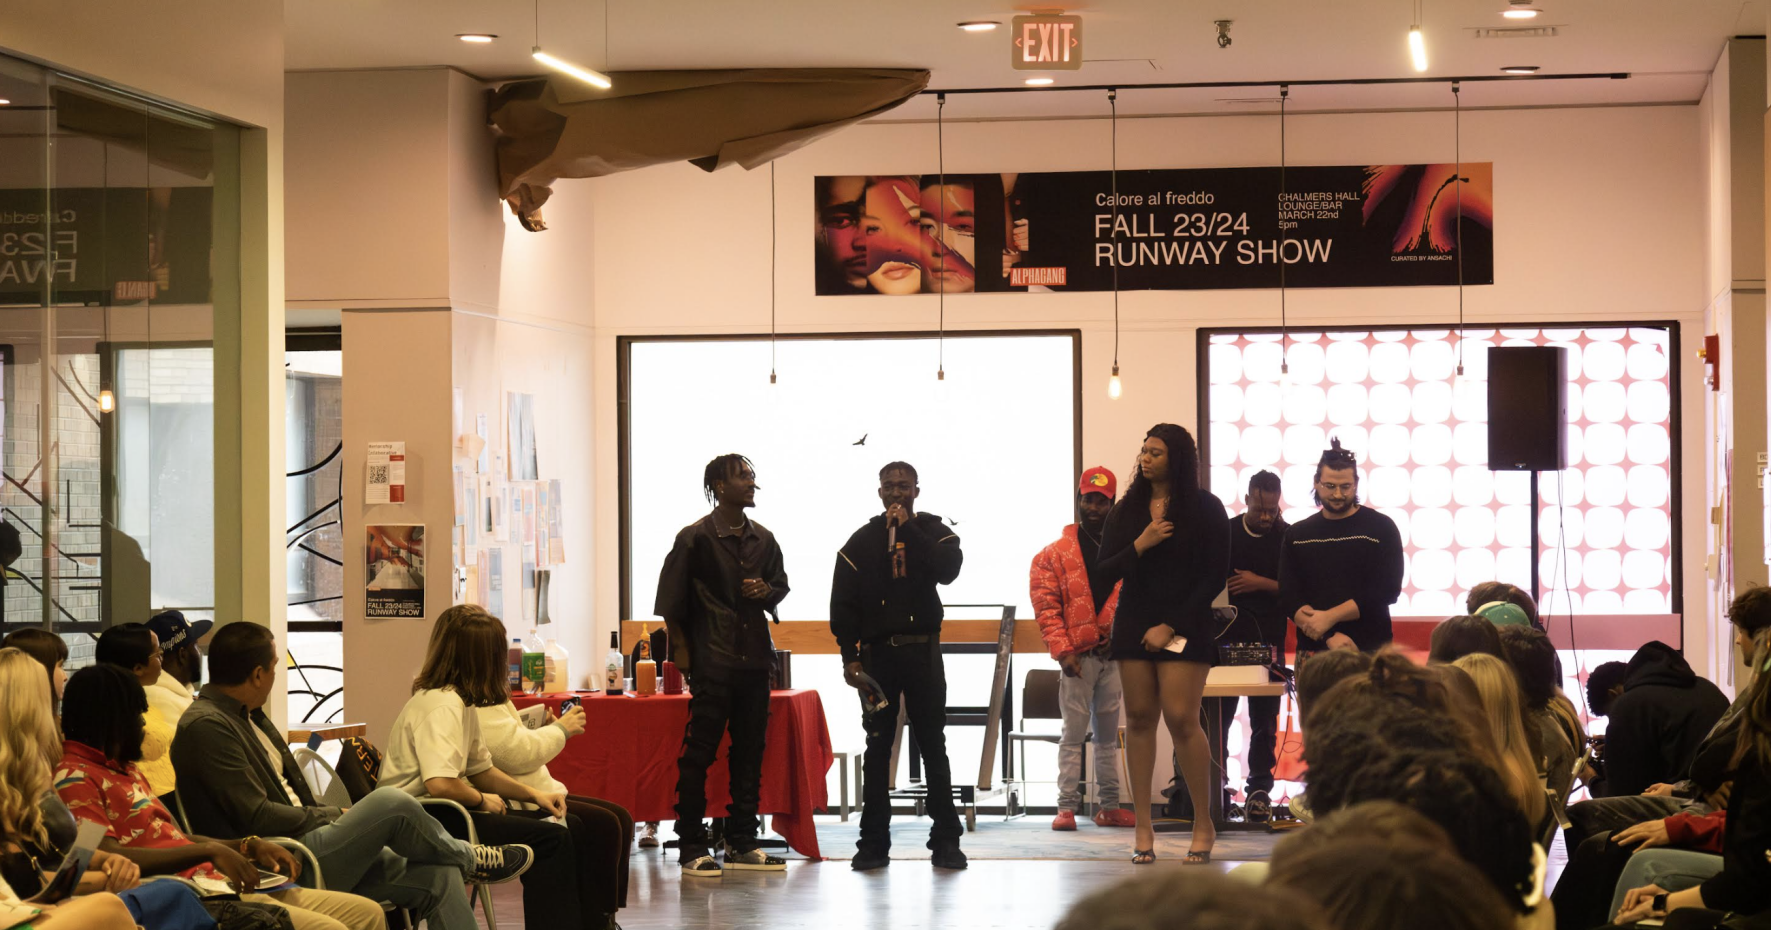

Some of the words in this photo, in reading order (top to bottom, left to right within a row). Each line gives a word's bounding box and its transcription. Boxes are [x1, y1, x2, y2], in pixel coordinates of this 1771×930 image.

[1023, 23, 1074, 62] EXIT
[1095, 192, 1143, 206] Calore
[1148, 192, 1161, 205] al
[1165, 191, 1215, 205] freddo
[1278, 192, 1333, 201] CHALMERS
[1335, 191, 1360, 200] HALL
[1278, 201, 1343, 210] LOUNGE/BAR
[1278, 211, 1315, 220] MARCH
[1316, 210, 1339, 219] 22nd
[1095, 213, 1165, 238] FALL
[1173, 212, 1250, 237] 23/24
[1278, 220, 1298, 230] 5pm
[1095, 241, 1228, 267] RUNWAY
[1236, 239, 1333, 264] SHOW
[1012, 267, 1065, 285] ALPHAGANG
